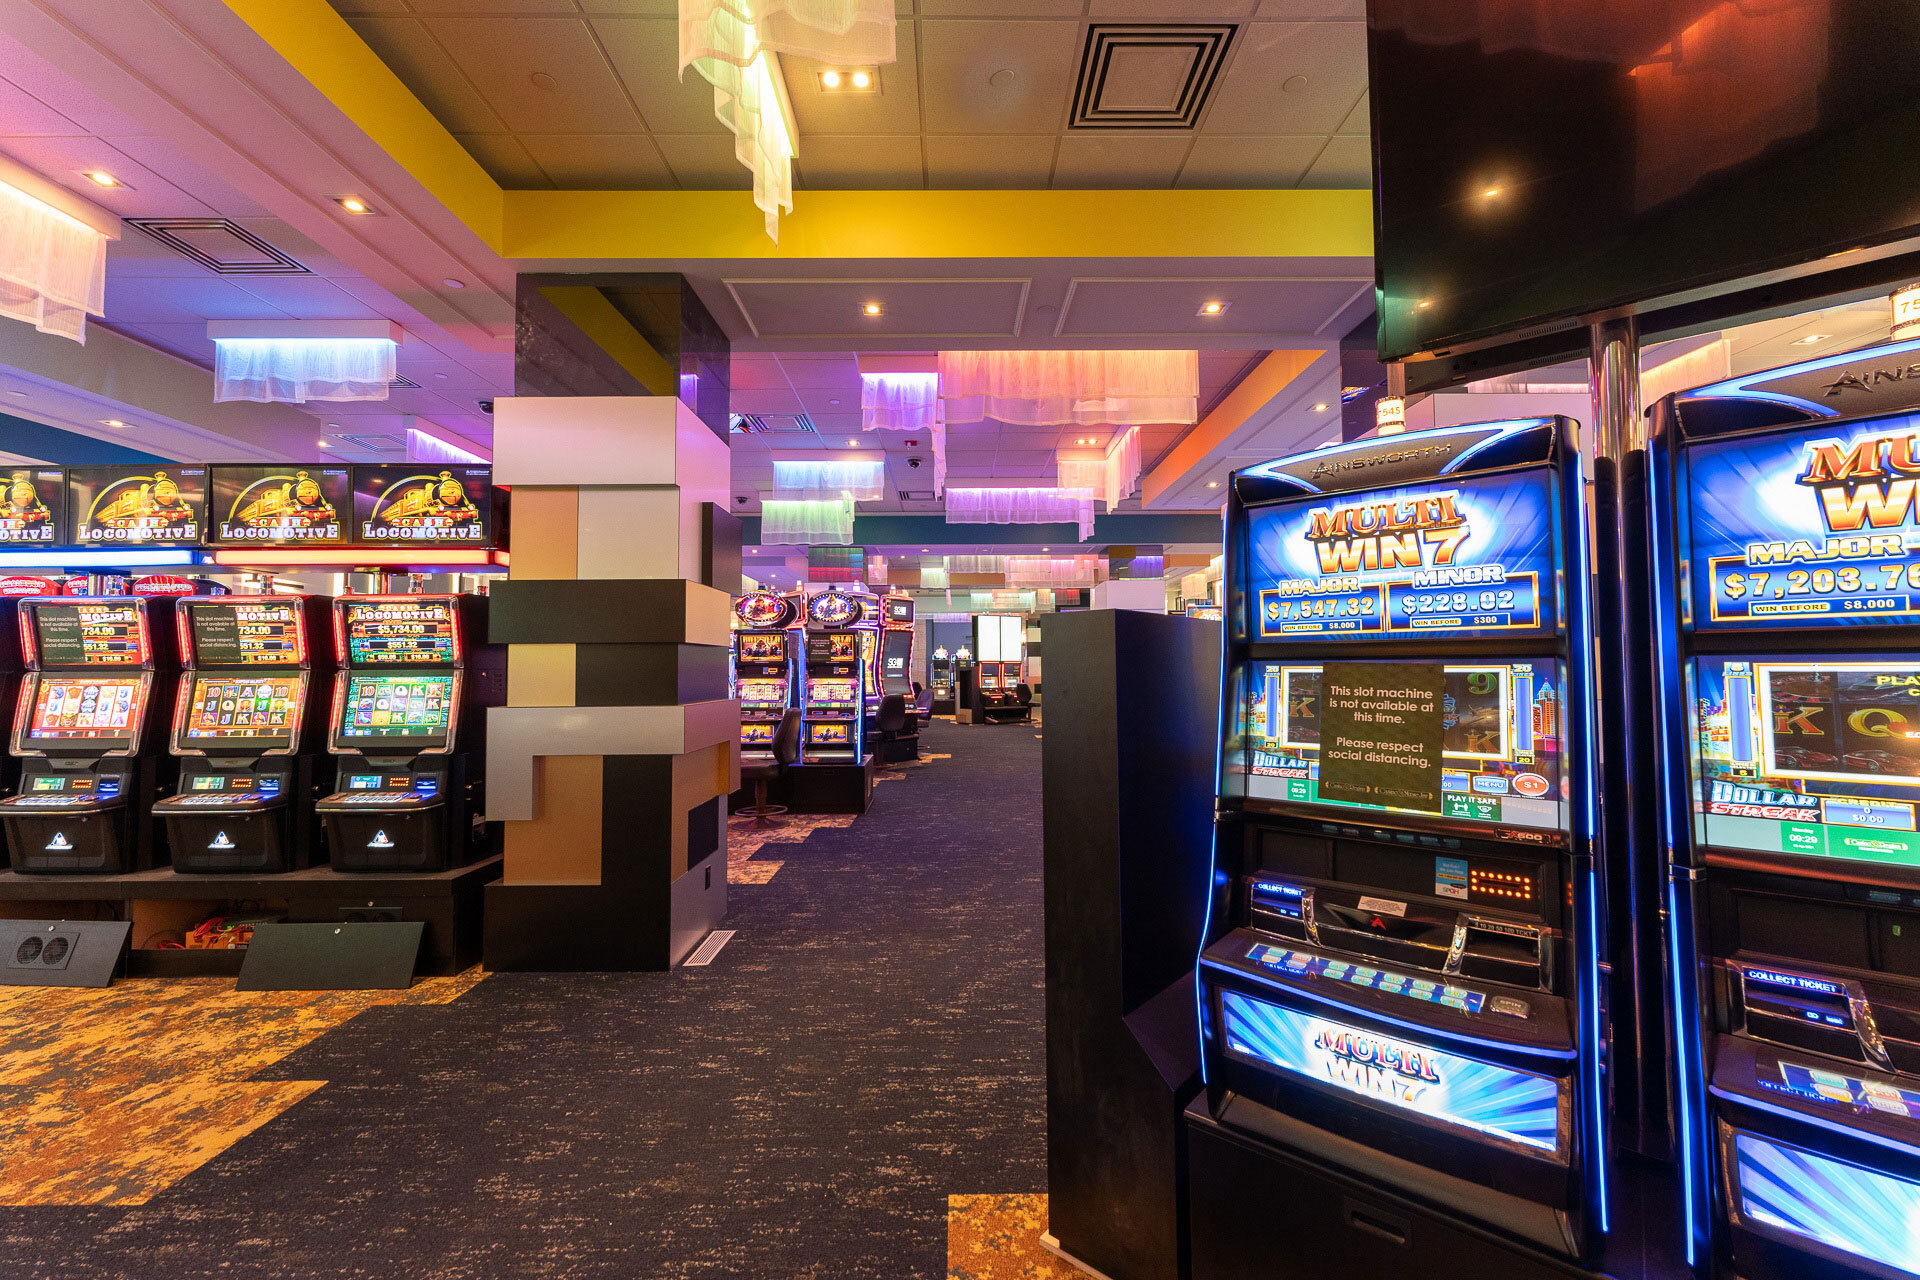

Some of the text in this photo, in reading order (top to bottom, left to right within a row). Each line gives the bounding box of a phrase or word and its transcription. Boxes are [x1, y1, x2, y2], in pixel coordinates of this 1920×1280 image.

[1378, 406, 1401, 417] 545
[1311, 443, 1452, 479] AINSWORTH
[118, 518, 161, 528] CASH
[258, 517, 304, 527] CASH
[401, 517, 446, 527] CASH
[1305, 495, 1466, 538] MULTI
[79, 524, 197, 540] LOCOMOTIVE
[221, 524, 338, 539] LOCOMOTIVE
[364, 524, 481, 539] LOCOMOTIVE
[1316, 532, 1423, 575] WIN
[1750, 535, 1906, 565] MAJOR
[1414, 566, 1505, 588] MINOR
[1281, 577, 1361, 597] MAJOR
[1268, 597, 1374, 621] $7,547.32
[1402, 589, 1515, 616] $228.02
[1781, 603, 1827, 611] BEFORE
[1844, 599, 1895, 610] $8,000
[357, 608, 443, 620] LOCOMOTIVE
[1474, 616, 1497, 624] $300
[378, 625, 425, 634] $5,734.00
[387, 641, 418, 649] $551.32
[1514, 664, 1532, 673] 20
[1330, 686, 1433, 699] This slot machine
[1329, 698, 1434, 712] is not available at
[1354, 712, 1405, 724] this time.
[1336, 737, 1424, 753] Please respect
[1253, 750, 1309, 768] DOLLAR
[1328, 750, 1432, 769] social distancing.
[1252, 767, 1309, 779] STREAK
[1712, 779, 1818, 807] DOLLAR
[1477, 797, 1497, 805] SAFE
[1837, 798, 1898, 807] CREDIT
[1710, 803, 1821, 822] STREAK
[1789, 834, 1818, 844] 09:29
[1258, 883, 1283, 893] COLLECT
[1749, 970, 1837, 992] COLLECT TICKET
[1314, 1030, 1440, 1084] MULTI
